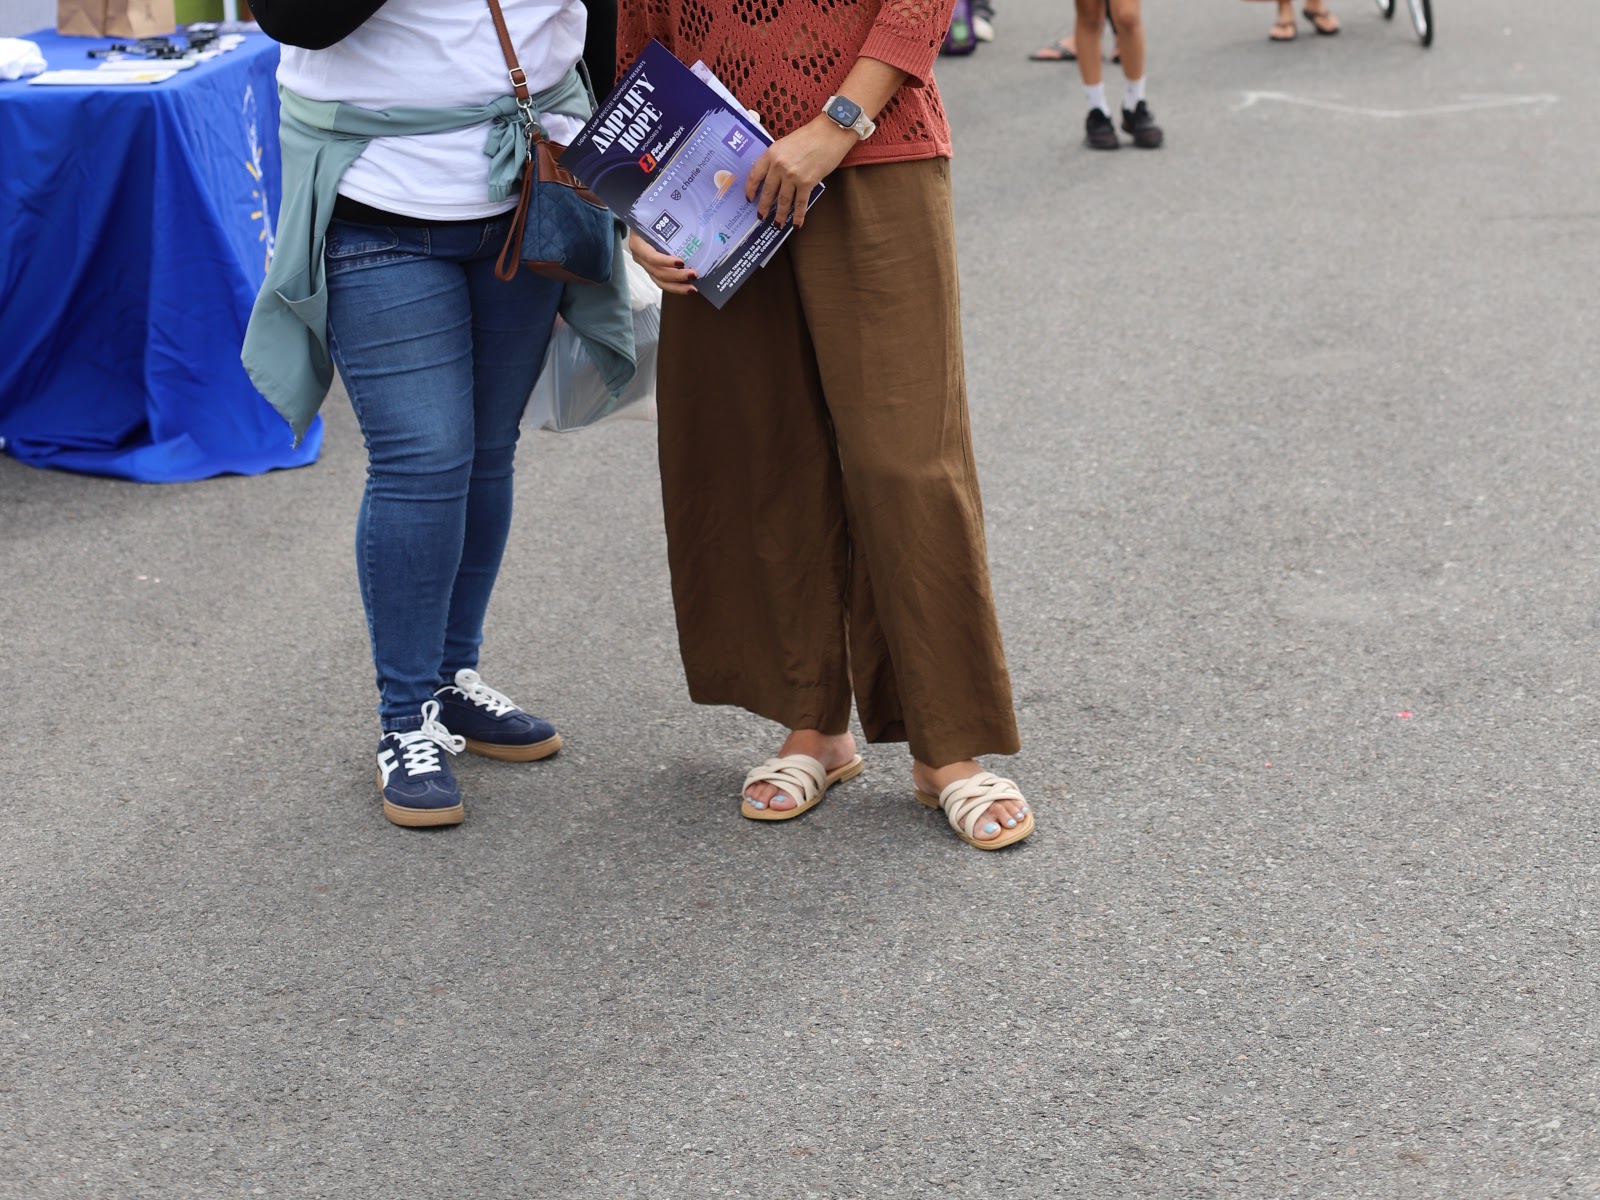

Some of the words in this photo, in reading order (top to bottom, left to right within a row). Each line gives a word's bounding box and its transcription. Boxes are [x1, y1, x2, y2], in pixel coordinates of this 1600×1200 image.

[577, 133, 588, 146] LIGHT
[612, 80, 631, 102] NONPROFIT
[629, 60, 646, 80] PRESENTS
[591, 72, 656, 154] AMPLIFY
[617, 102, 663, 153] HOPE
[641, 129, 659, 152] SPONSORED
[727, 130, 743, 149] ME
[651, 142, 663, 156] First
[655, 136, 677, 162] Interstate
[674, 125, 685, 138] Bank
[649, 160, 684, 202] COMMUNITY
[684, 126, 712, 158] PARTNERS
[680, 166, 701, 191] charlie
[698, 148, 715, 169] health
[655, 216, 670, 231] 988
[725, 211, 742, 230] Inland
[731, 207, 755, 234] BEHAVIORAL
[674, 233, 695, 256] FAILSAFE
[678, 237, 703, 263] LIFE
[719, 271, 733, 285] SPECIAL
[732, 259, 743, 271] THANK
[743, 251, 751, 259] YOU
[754, 238, 762, 246] THE
[760, 226, 772, 239] SOCIAL
[719, 276, 734, 292] AMPLIFY
[732, 267, 742, 277] HOPE
[741, 260, 749, 268] AND
[747, 245, 761, 260] HELPING
[764, 230, 774, 240] BRING
[733, 267, 747, 283] SUPPORT
